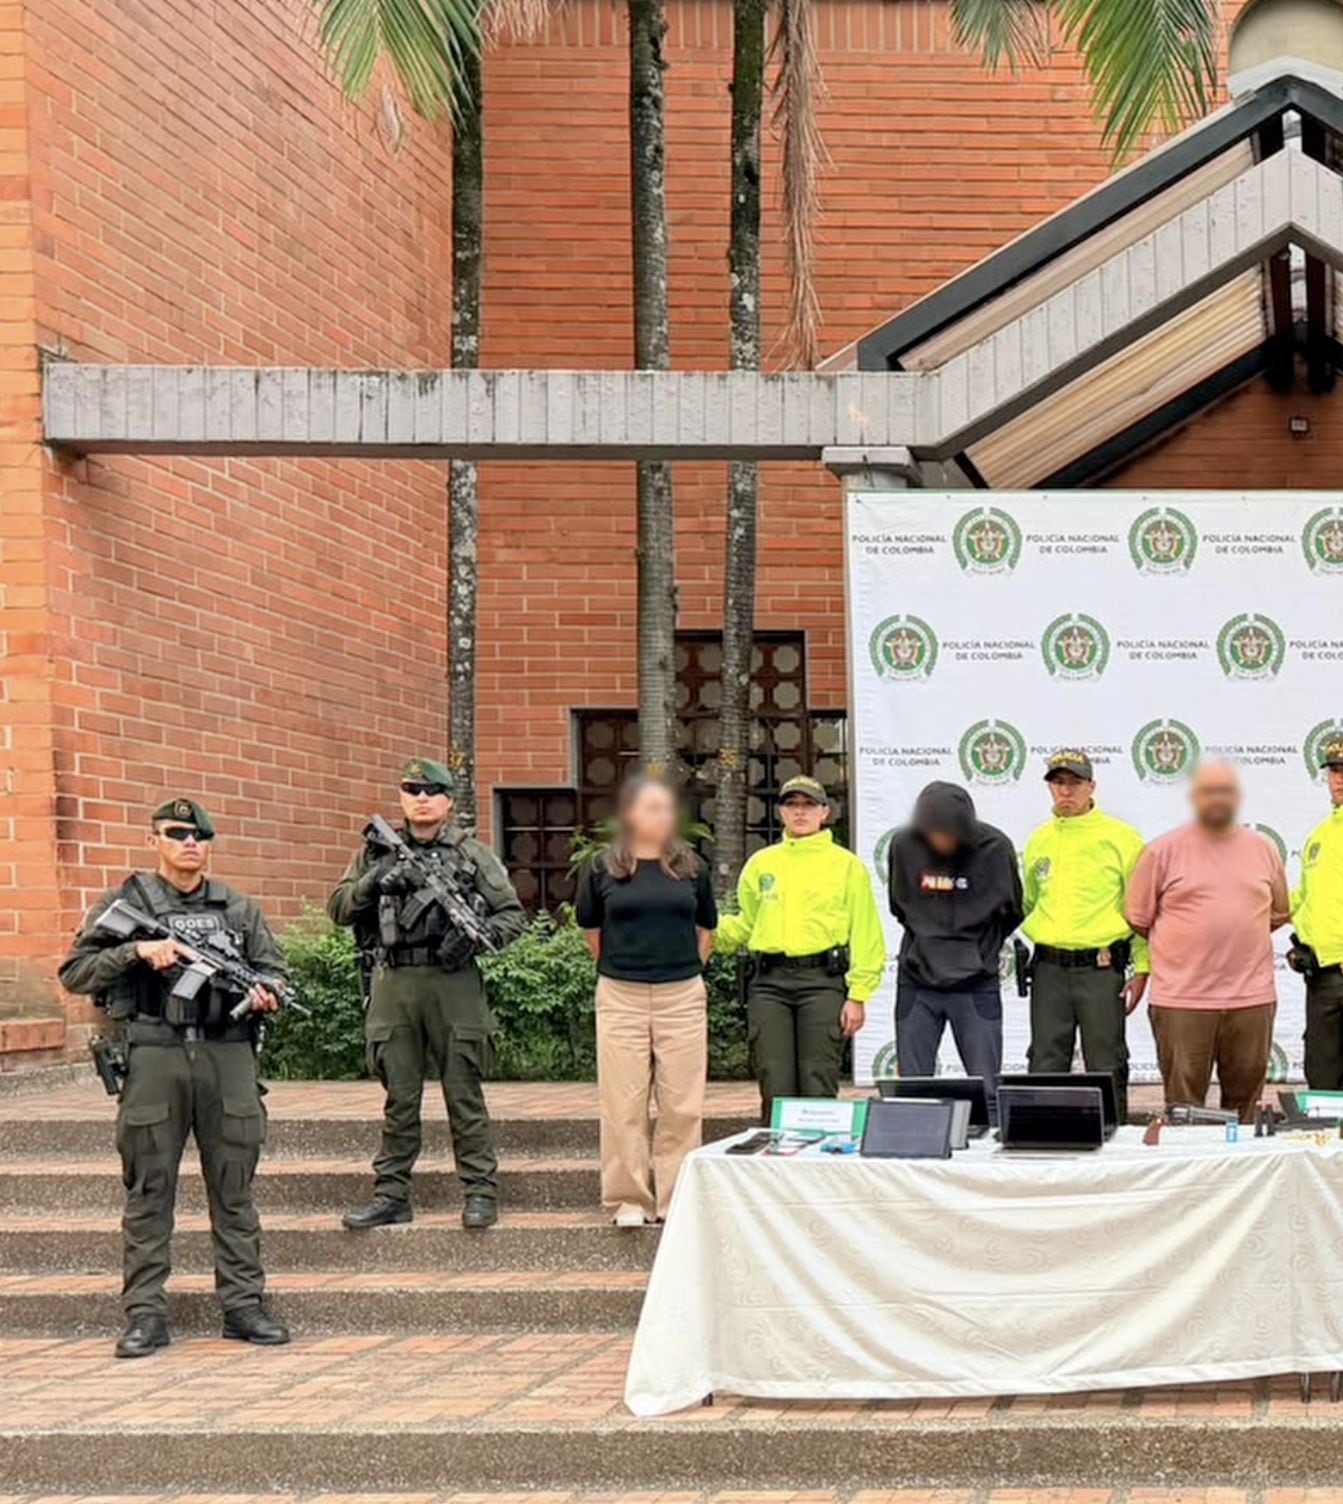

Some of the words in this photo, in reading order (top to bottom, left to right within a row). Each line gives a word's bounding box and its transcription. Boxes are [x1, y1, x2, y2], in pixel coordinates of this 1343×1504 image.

[853, 533, 892, 543] POLICÍA
[895, 535, 946, 543] NACIONAL
[1026, 533, 1065, 542] POLICÍA
[1203, 533, 1241, 543] POLICÍA
[866, 546, 878, 554] DE
[882, 546, 934, 554] COLOMBIA
[1040, 546, 1052, 554] DE
[1215, 546, 1228, 554] DE
[1231, 546, 1283, 554] COLOMBIA
[943, 641, 981, 649] POLICÍA
[984, 641, 1035, 649] NACIONAL
[1158, 640, 1208, 648] NACIONAL
[1290, 641, 1328, 649] POLICÍA
[971, 652, 1022, 660] COLOMBIA
[1302, 651, 1314, 659] DE
[860, 745, 899, 755] POLICÍA
[1247, 745, 1297, 753] NACIONAL
[888, 758, 940, 766] COLOMBIA
[174, 918, 215, 931] GOES
